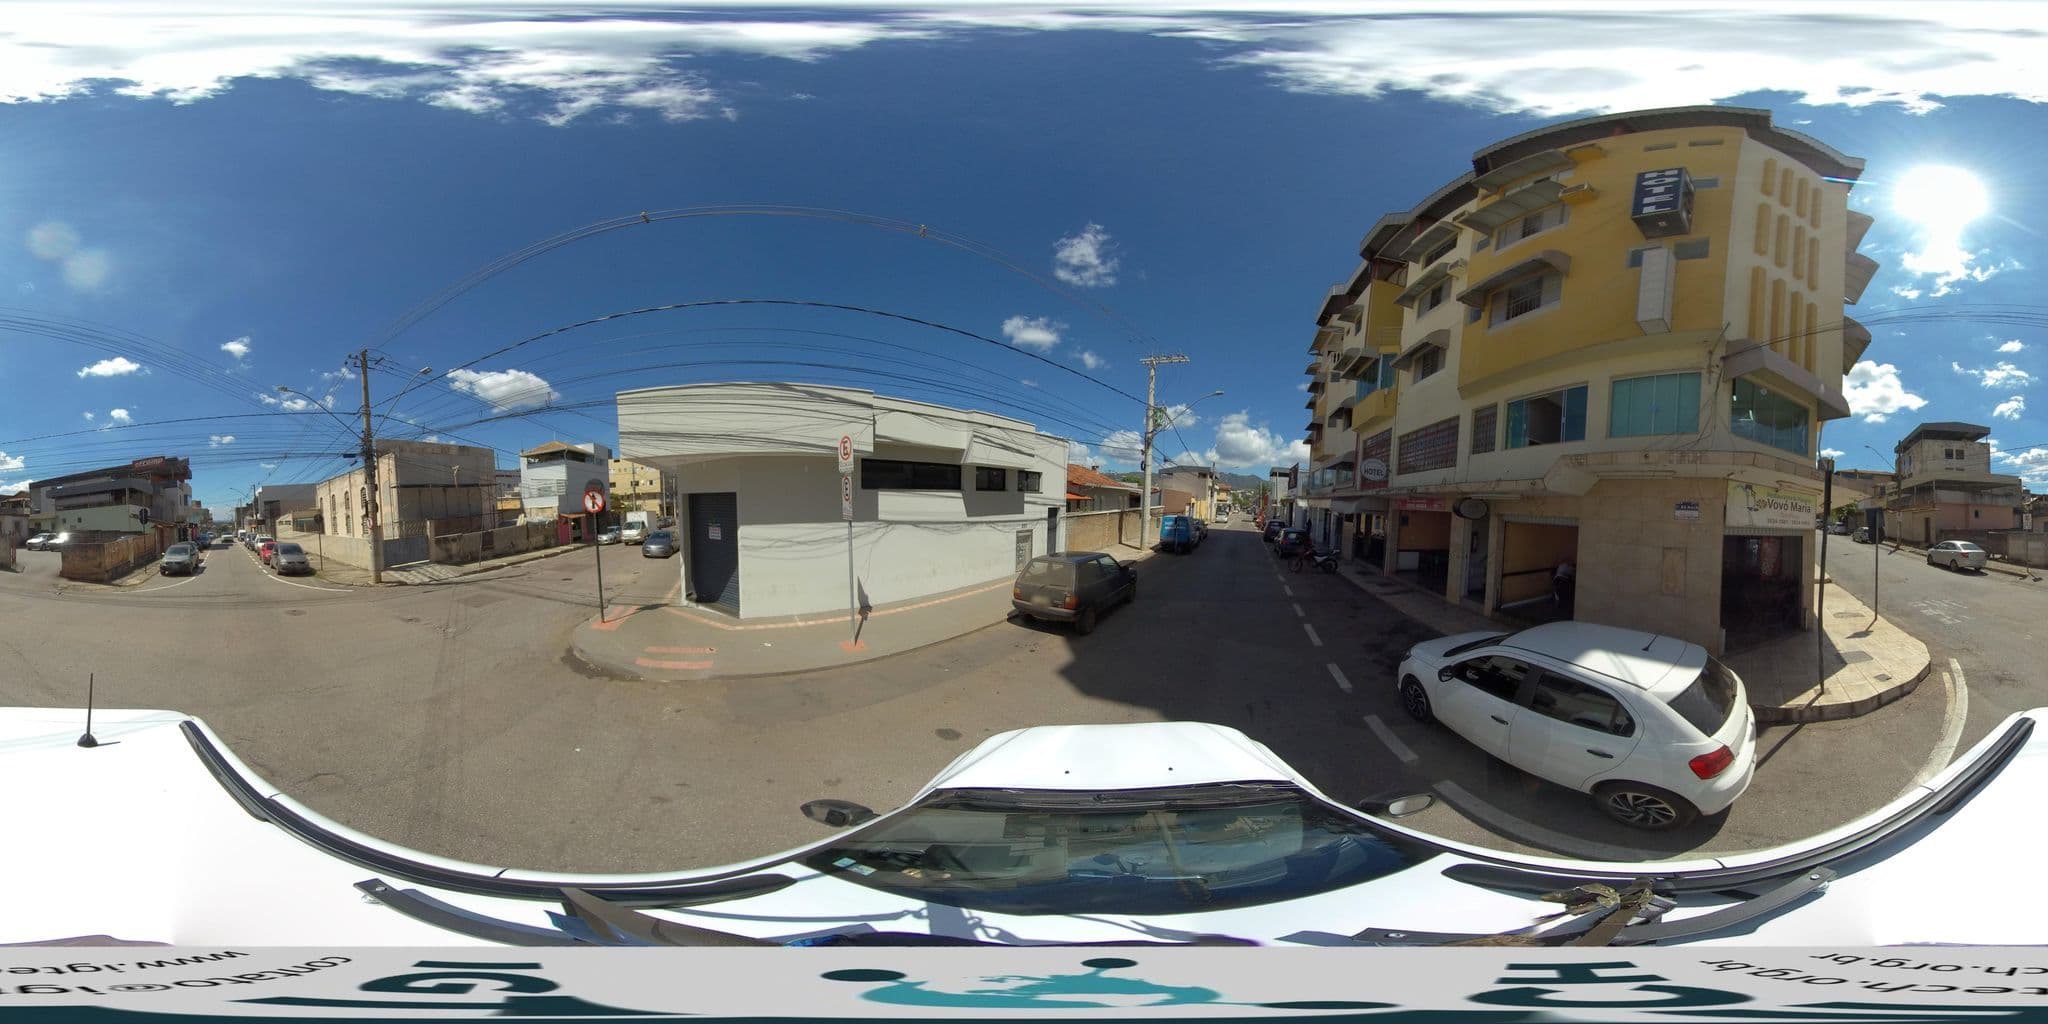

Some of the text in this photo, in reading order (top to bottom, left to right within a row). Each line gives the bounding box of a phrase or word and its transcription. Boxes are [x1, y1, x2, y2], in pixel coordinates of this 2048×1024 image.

[1641, 170, 1679, 213] HOTEL
[1364, 467, 1384, 477] HOTEL
[1790, 502, 1811, 513] Maria
